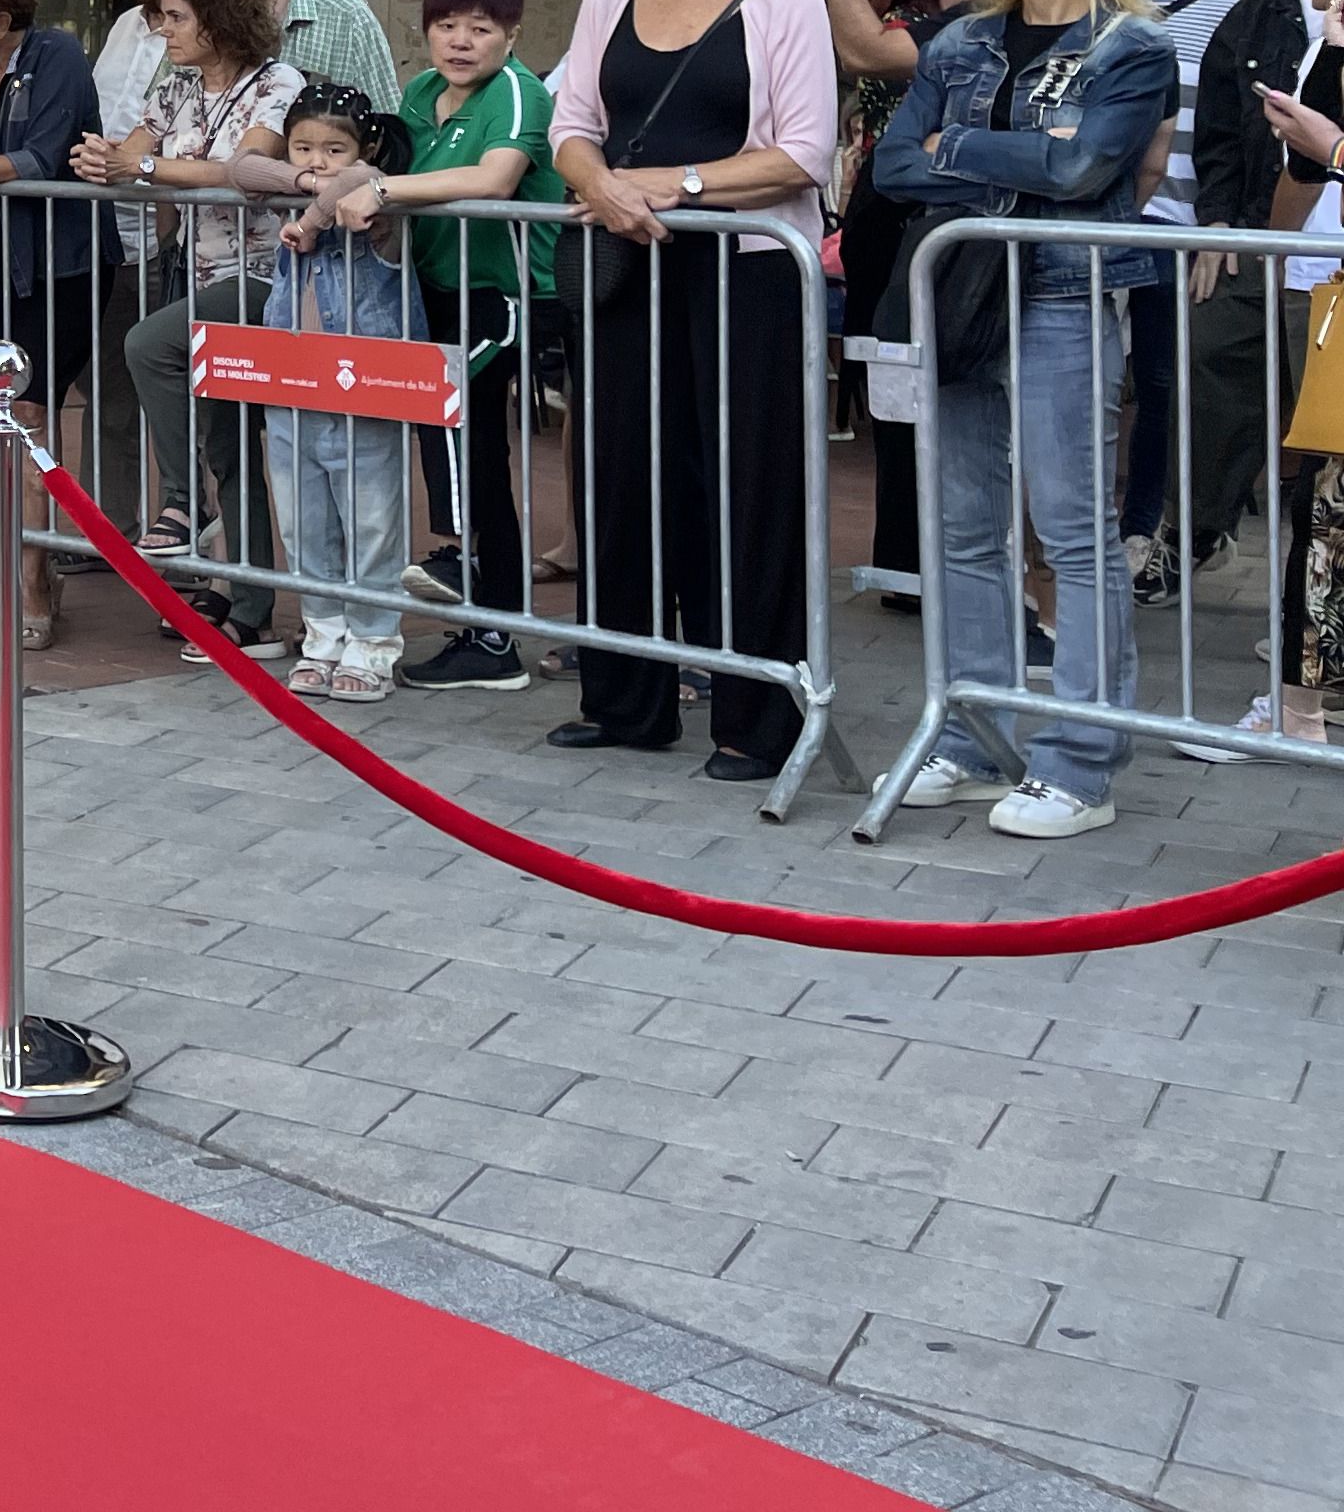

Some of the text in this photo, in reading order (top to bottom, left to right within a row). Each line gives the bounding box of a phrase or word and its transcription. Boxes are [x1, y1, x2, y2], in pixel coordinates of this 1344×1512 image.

[213, 356, 255, 369] DISCULPEU
[213, 369, 227, 379] LES
[361, 375, 405, 388] Ajuntament
[407, 379, 417, 390] de
